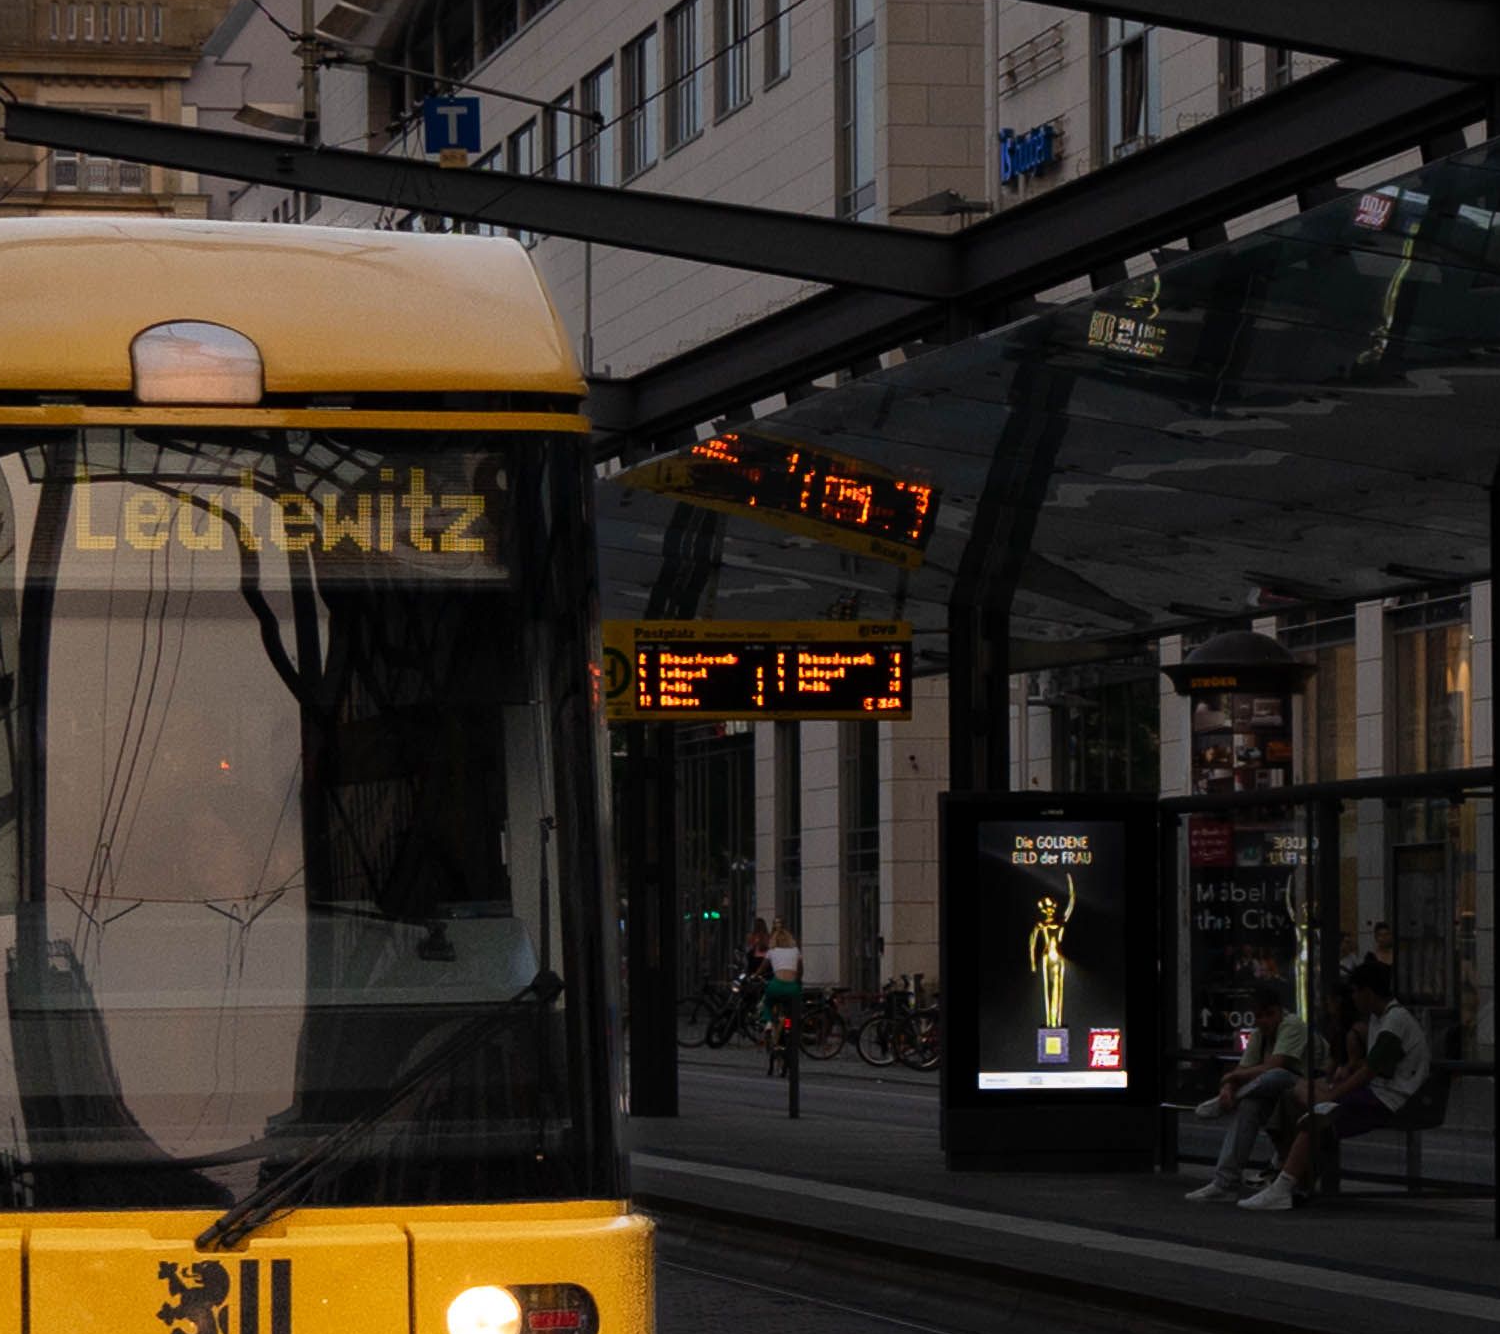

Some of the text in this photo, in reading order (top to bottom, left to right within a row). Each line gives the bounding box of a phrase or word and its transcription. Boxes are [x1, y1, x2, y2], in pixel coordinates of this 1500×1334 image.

[437, 107, 467, 144] T
[76, 467, 486, 553] Leutewitz
[635, 628, 695, 641] Postplatz
[1016, 836, 1088, 849] Die GOLDENE
[1012, 851, 1092, 865] BILD der FRAU
